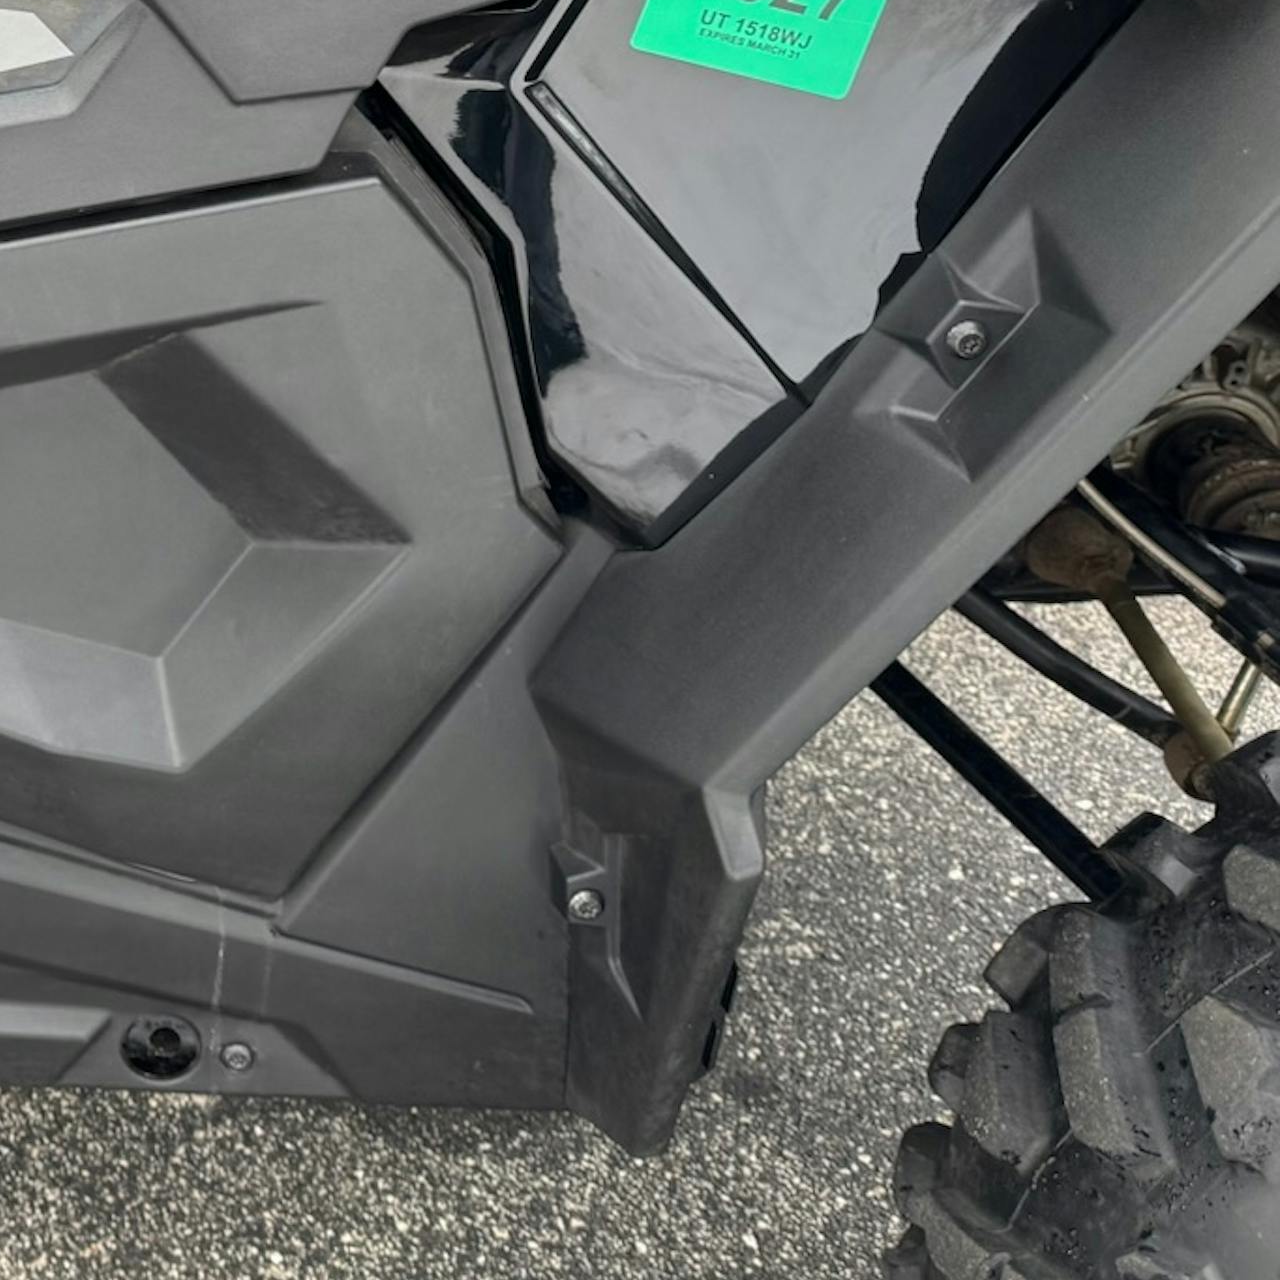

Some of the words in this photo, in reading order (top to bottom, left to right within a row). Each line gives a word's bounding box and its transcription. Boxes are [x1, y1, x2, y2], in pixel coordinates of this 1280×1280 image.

[699, 28, 745, 46] EXPIRES
[746, 39, 786, 57] MARCH
[700, 9, 731, 28] UT
[735, 18, 813, 50] 1518WJ
